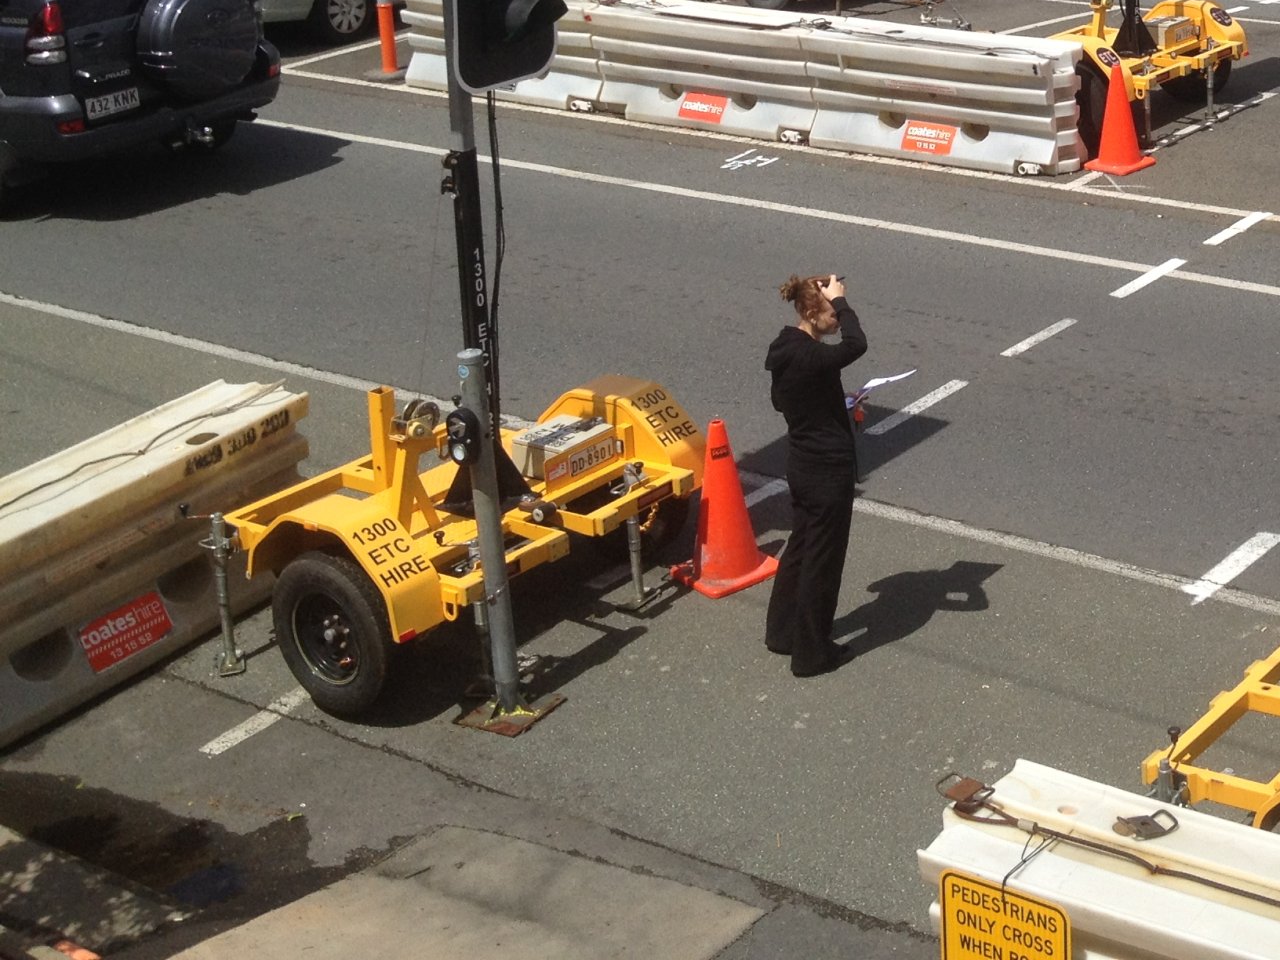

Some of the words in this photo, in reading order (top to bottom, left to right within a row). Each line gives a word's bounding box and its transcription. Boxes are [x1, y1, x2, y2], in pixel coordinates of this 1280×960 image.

[113, 89, 138, 108] KNK
[473, 247, 486, 308] 1300
[630, 389, 667, 412] 1300
[645, 405, 680, 429] ETC
[657, 420, 697, 448] HIRE
[352, 517, 398, 546] 1300
[368, 537, 411, 566] ETC
[379, 554, 431, 589] HIRE
[951, 883, 1058, 933] PEDESTRIANS
[956, 908, 996, 935] ONLY
[1002, 924, 1054, 956] CROSS
[959, 933, 1003, 960] WHEN
